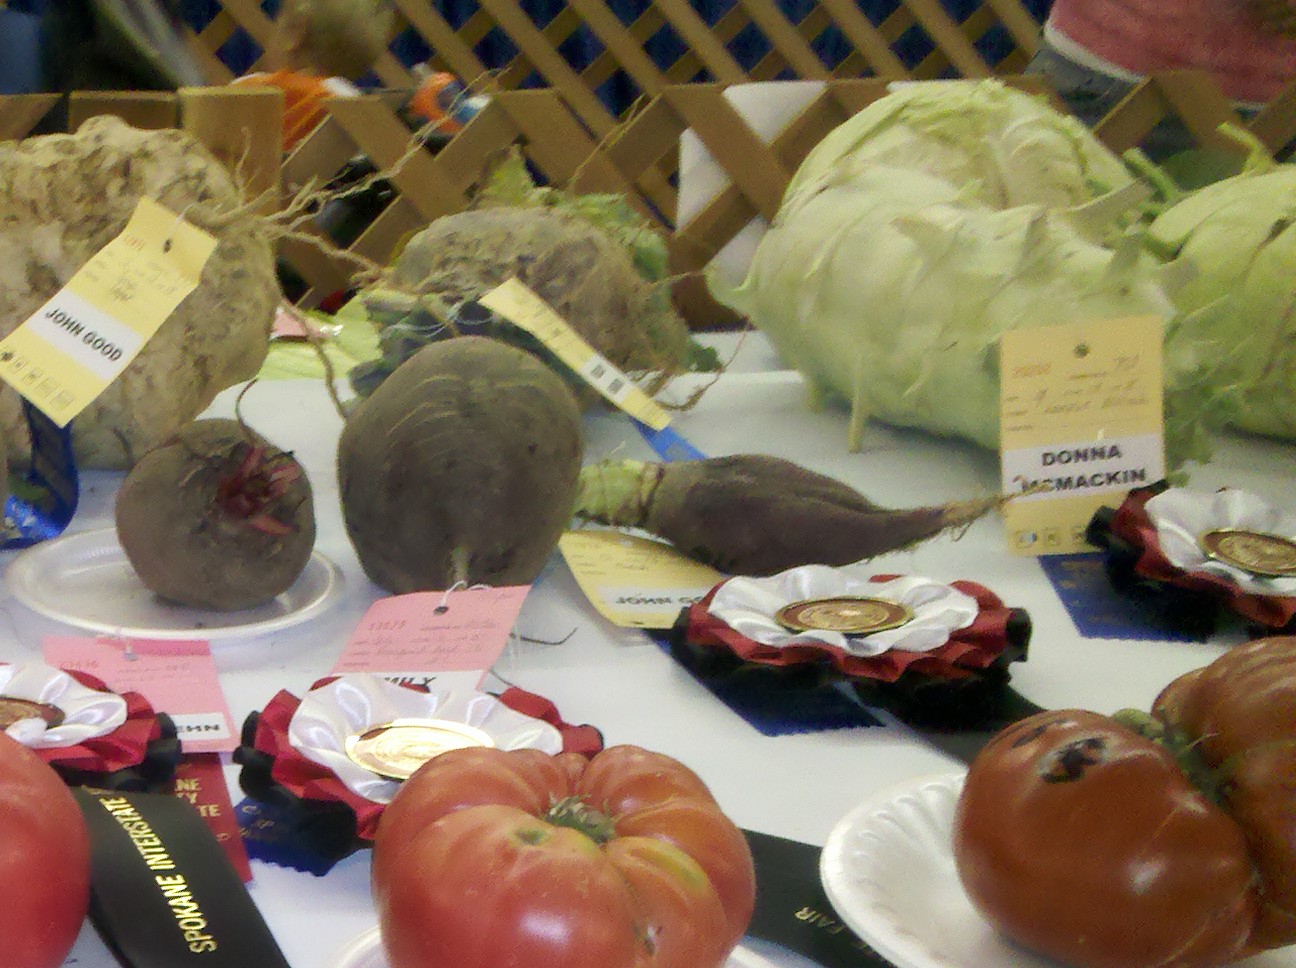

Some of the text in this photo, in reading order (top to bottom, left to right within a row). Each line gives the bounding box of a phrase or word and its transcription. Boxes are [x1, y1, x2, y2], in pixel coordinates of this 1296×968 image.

[45, 308, 124, 363] JOHN GOOD
[1041, 444, 1122, 467] DONNA
[99, 797, 218, 953] SPOKANE INTERSTATE
